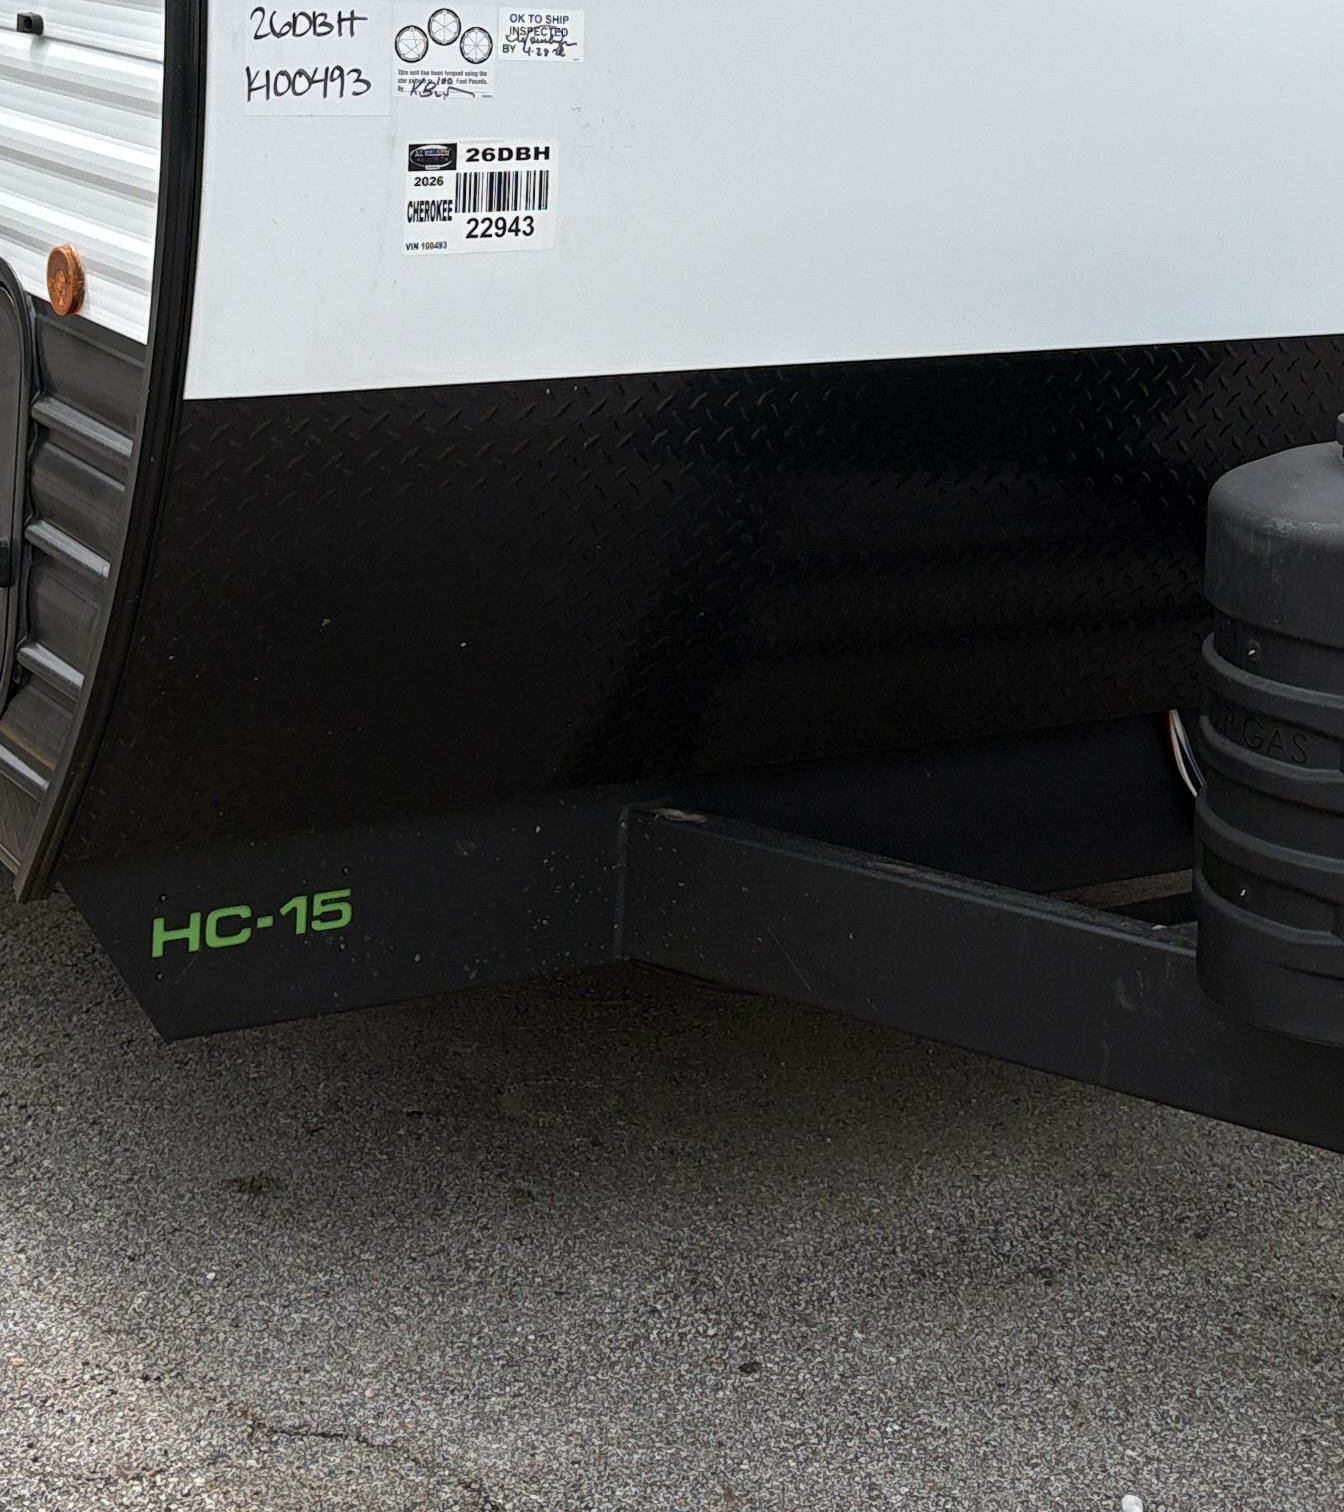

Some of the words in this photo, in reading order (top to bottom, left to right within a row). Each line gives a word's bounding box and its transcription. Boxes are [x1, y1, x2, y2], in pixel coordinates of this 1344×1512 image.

[249, 6, 368, 40] 26DBH
[509, 13, 526, 24] OK
[528, 14, 543, 24] TO
[545, 14, 570, 25] SHIP
[509, 25, 569, 37] INSPECTED
[502, 44, 517, 54] BY
[465, 146, 550, 162] 26DBH
[414, 176, 444, 187] 2026
[407, 199, 453, 223] CHEROKEE
[465, 215, 535, 239] 22943
[406, 243, 419, 251] VIN
[151, 888, 353, 959] HC-15
